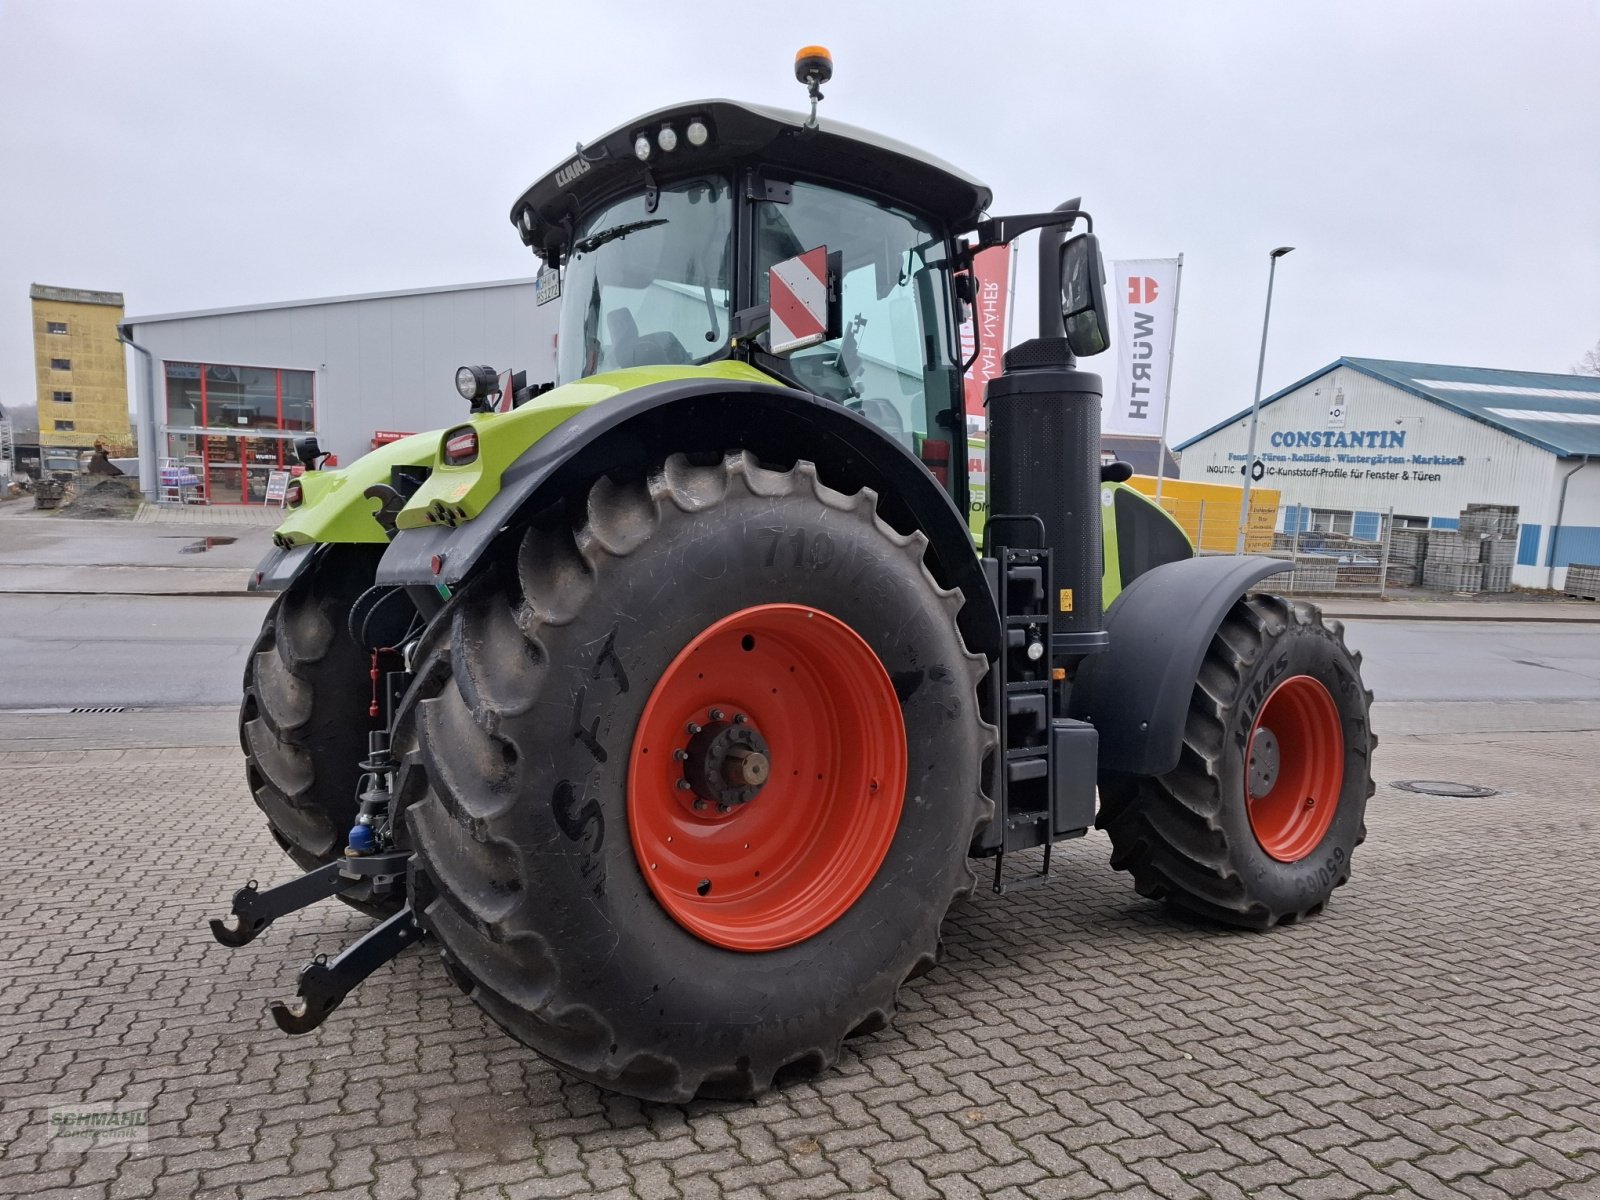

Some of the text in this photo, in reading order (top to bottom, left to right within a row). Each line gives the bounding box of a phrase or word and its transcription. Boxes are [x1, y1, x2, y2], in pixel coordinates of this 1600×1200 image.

[555, 158, 591, 187] CLAAS
[1271, 431, 1406, 448] CONSTANTIN
[1337, 453, 1405, 465] Wintergärten
[1207, 465, 1235, 474] INOUTIC
[1350, 469, 1363, 479] für
[1365, 470, 1399, 480] Fenster
[1401, 471, 1410, 481] &
[1412, 471, 1441, 482] Türen
